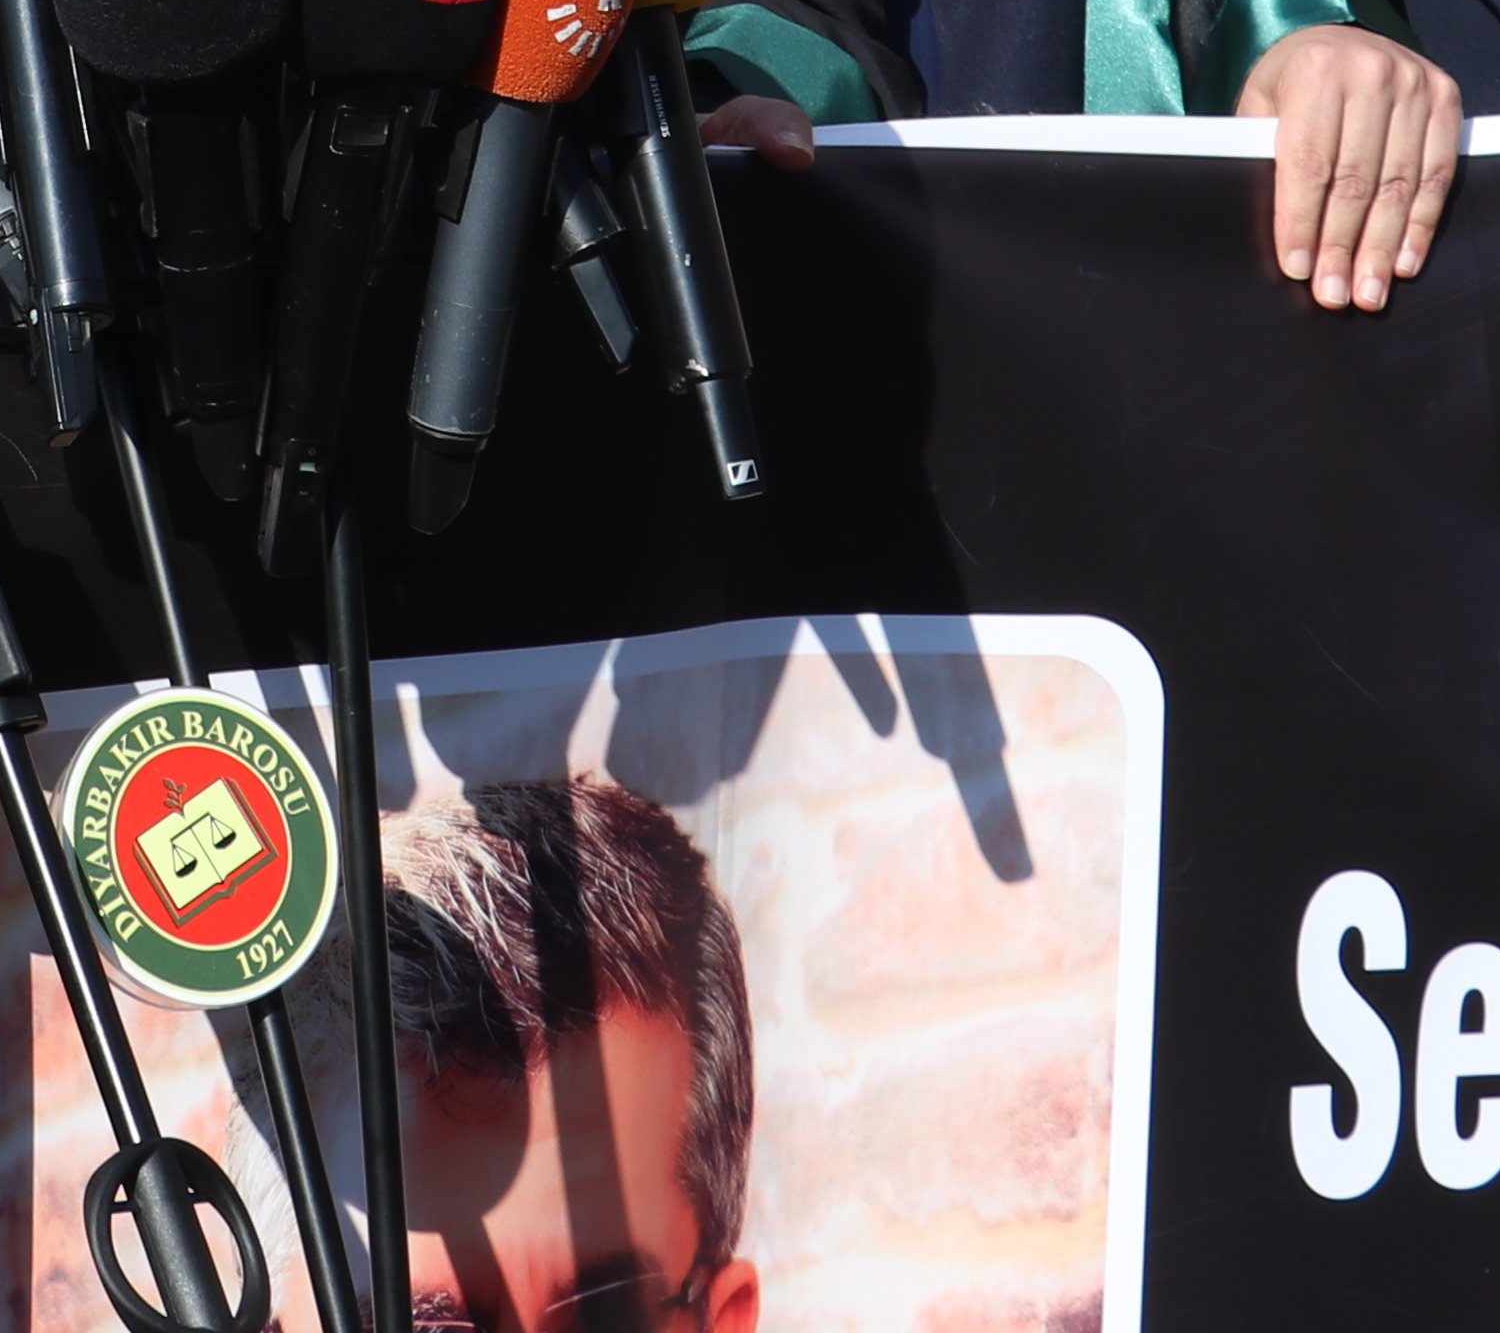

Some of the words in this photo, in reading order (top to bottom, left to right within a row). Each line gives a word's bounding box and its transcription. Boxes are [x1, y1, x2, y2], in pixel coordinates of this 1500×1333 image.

[83, 716, 176, 942] DİYARBAKIR
[182, 711, 310, 817] BAROSU
[235, 919, 294, 980] 1927
